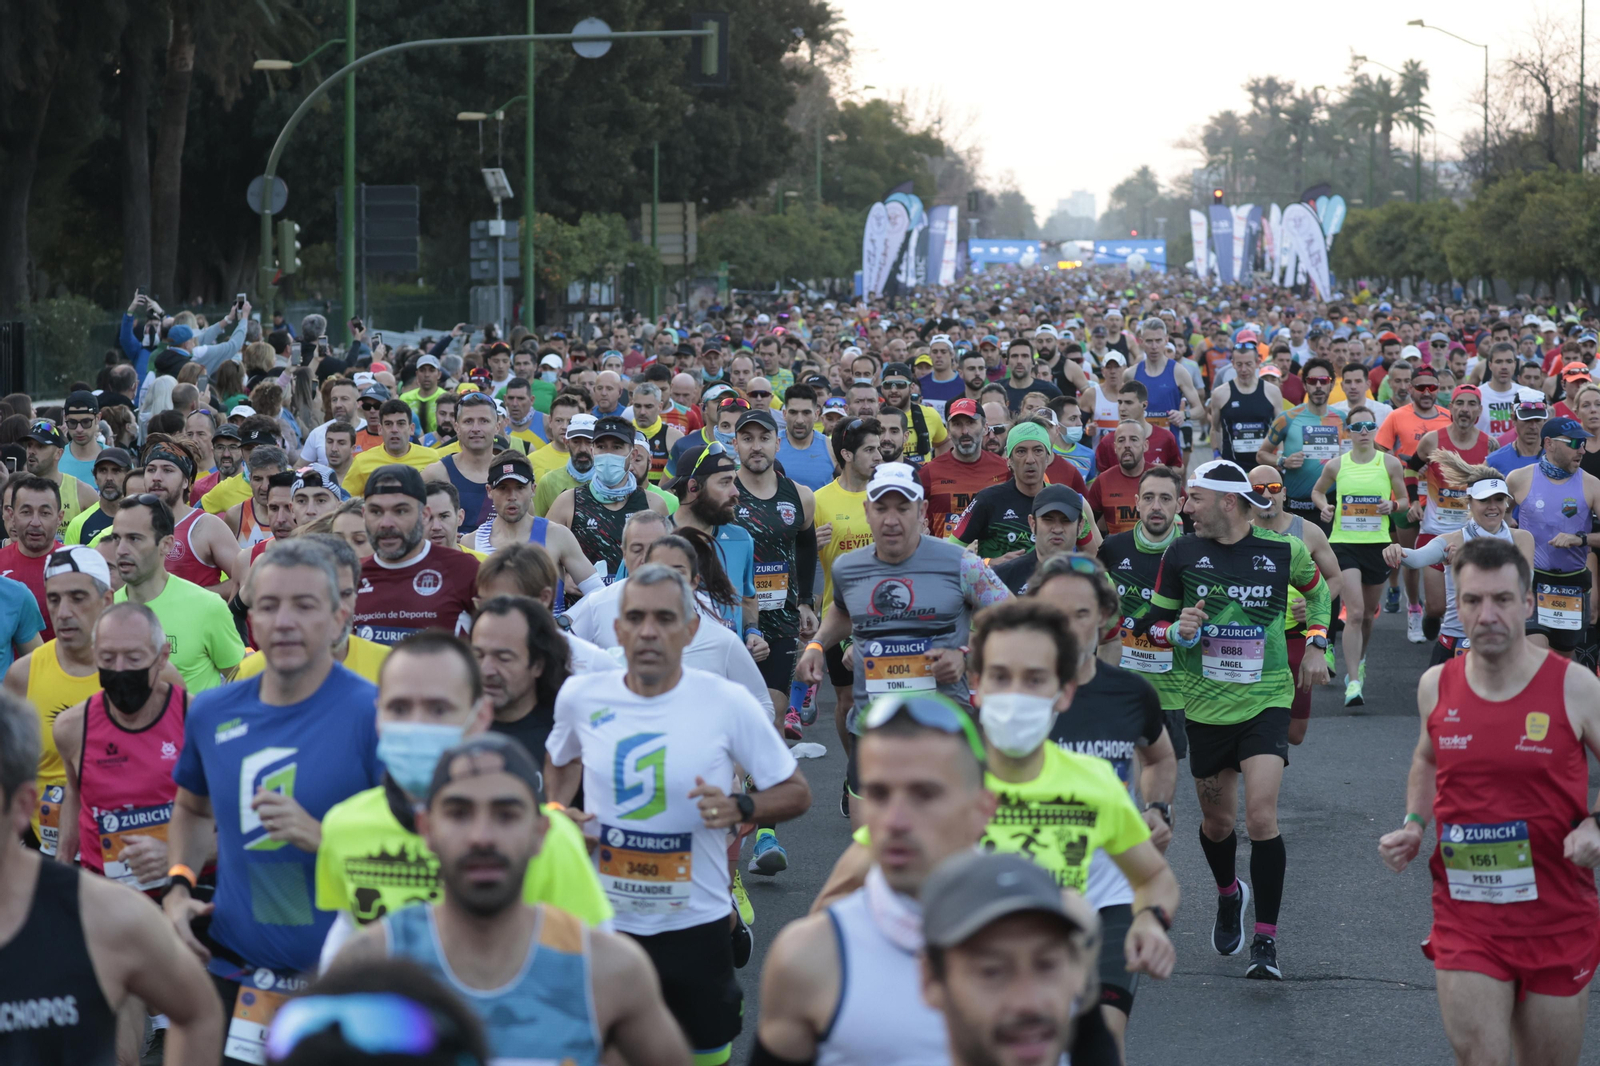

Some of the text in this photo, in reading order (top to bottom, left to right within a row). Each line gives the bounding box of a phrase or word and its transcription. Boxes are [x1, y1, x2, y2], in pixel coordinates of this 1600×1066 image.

[1490, 420, 1513, 433] RU
[756, 564, 783, 573] ZURICH
[399, 610, 437, 619] Deportes
[375, 631, 408, 640] ZURIC
[1220, 628, 1257, 637] ZURICH
[885, 643, 925, 653] ZURICH
[1135, 638, 1152, 648] 372
[1131, 650, 1156, 660] MANUEL
[1221, 646, 1242, 656] 6888
[1220, 660, 1243, 668] ANGEL
[887, 665, 910, 674] 4004
[1076, 740, 1134, 759] KACHOPOS
[121, 808, 170, 827] ZURICH
[1465, 826, 1516, 840] ZURICH
[627, 834, 680, 850] ZURICH
[1470, 854, 1498, 866] 1561
[627, 862, 659, 876] 3460
[1472, 875, 1502, 884] PETER
[613, 881, 673, 895] ALEXANDRE
[0, 994, 80, 1032] CHOPOS
